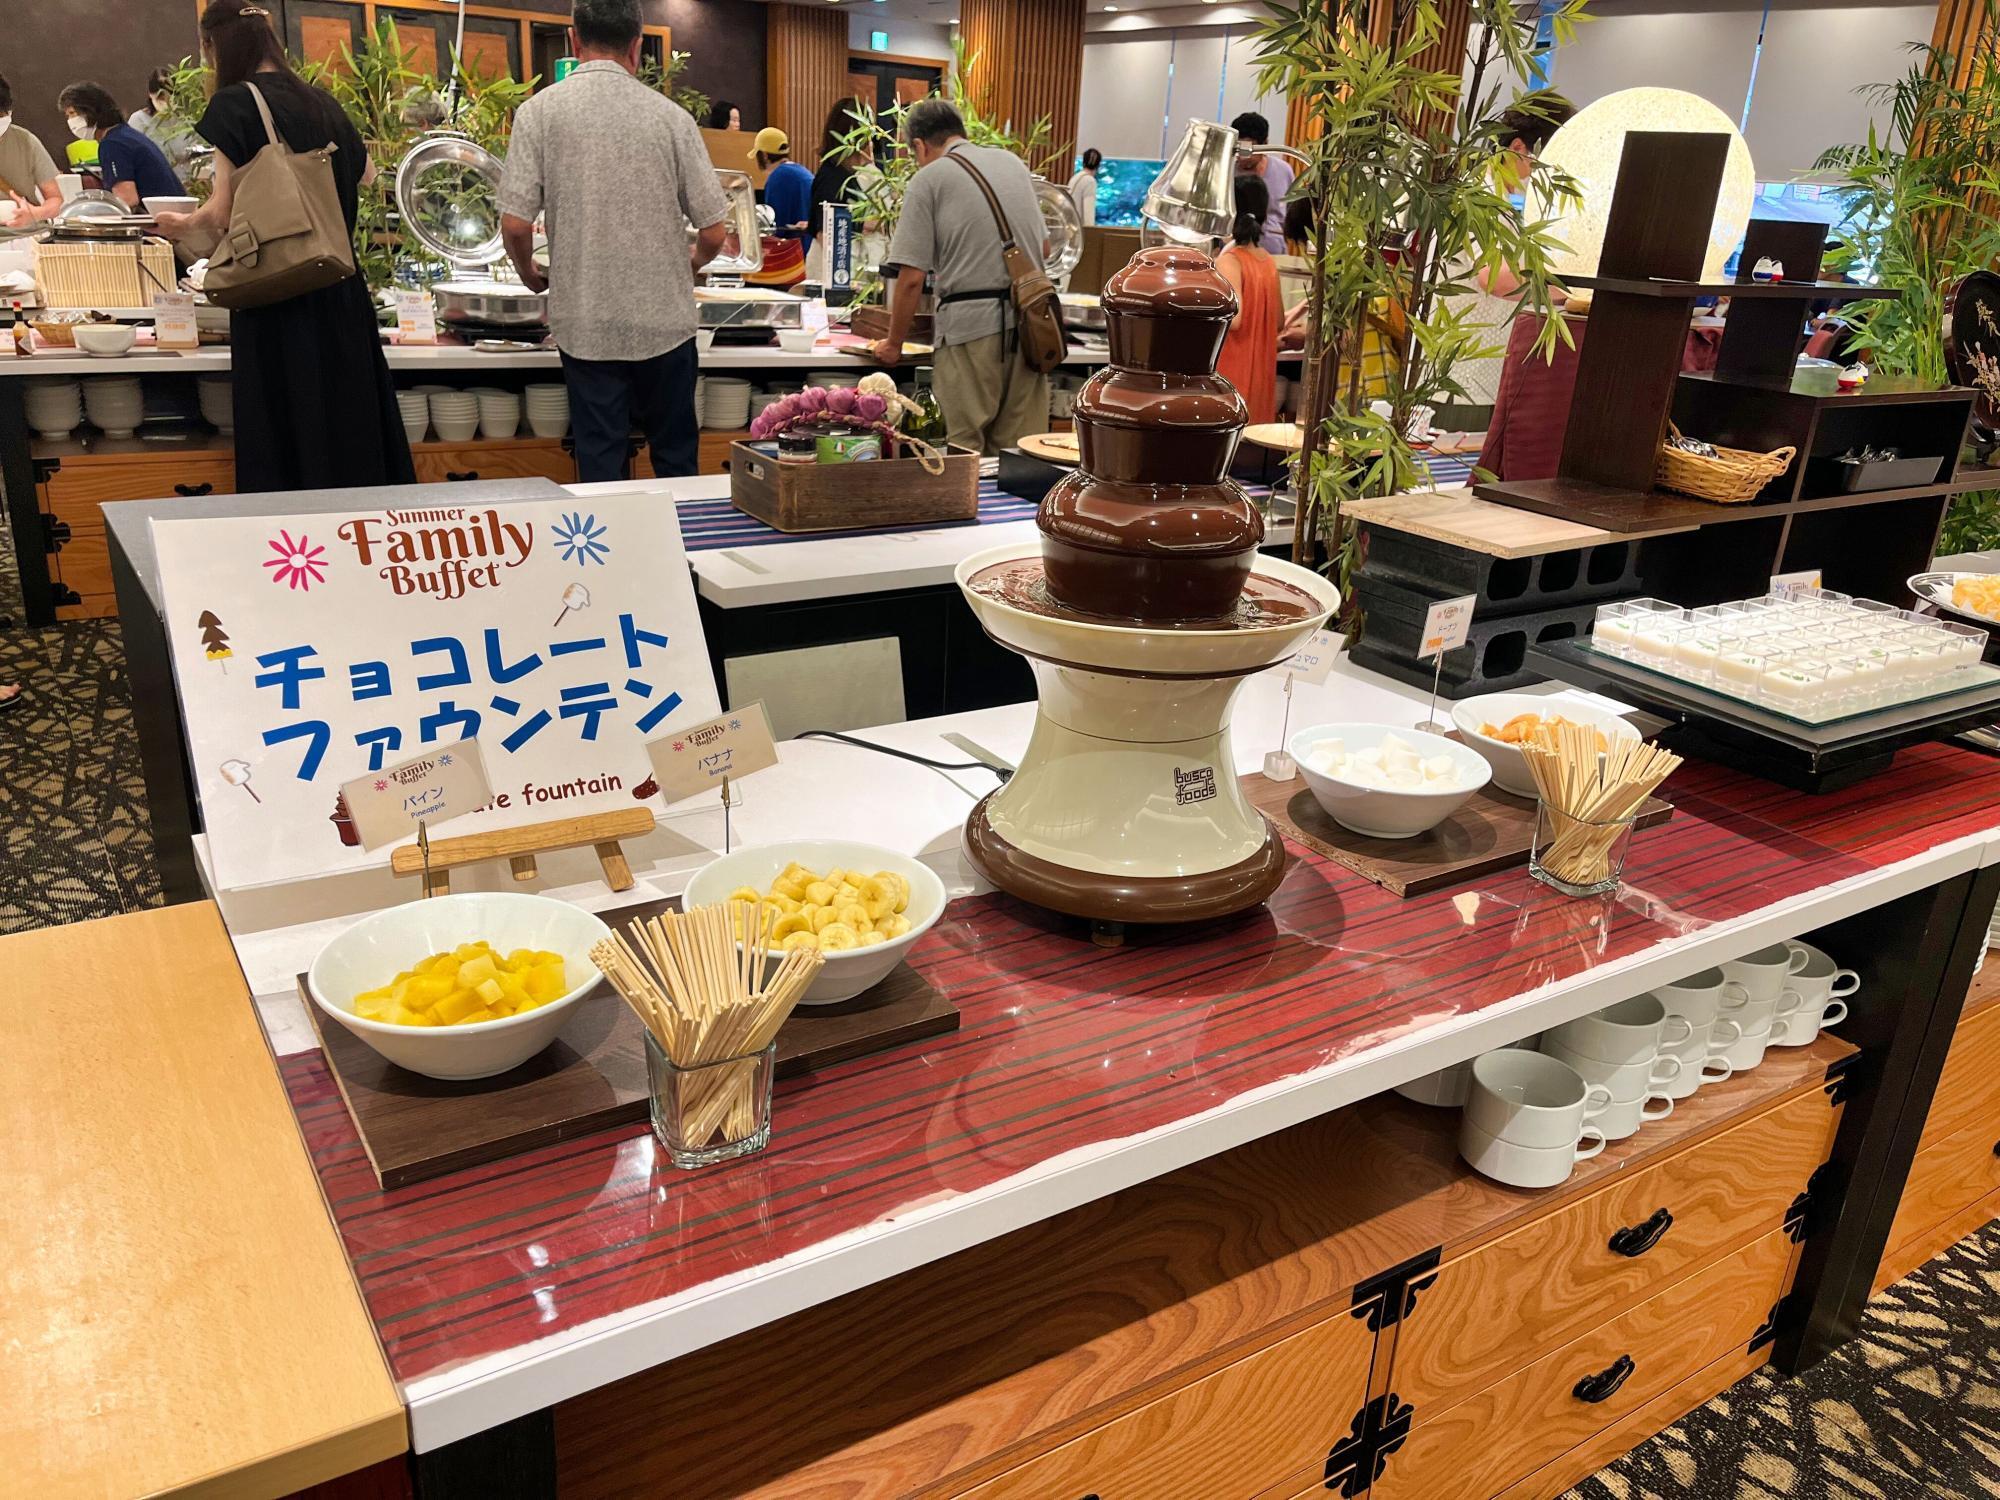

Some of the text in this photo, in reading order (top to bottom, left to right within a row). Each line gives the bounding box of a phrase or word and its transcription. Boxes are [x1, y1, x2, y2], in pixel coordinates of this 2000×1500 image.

[386, 508, 466, 527] Summer
[337, 509, 534, 568] Family
[379, 559, 501, 601] Buffet
[255, 613, 669, 709] チョコレート
[262, 678, 683, 782] ファウンテン
[685, 724, 726, 744] Family
[389, 760, 435, 782] Family
[698, 748, 733, 771] バナナ
[708, 763, 733, 776] Banana
[1174, 767, 1213, 784] busco
[521, 772, 623, 805] fountain
[1176, 780, 1216, 804] foods
[410, 801, 446, 819] Pineapple
